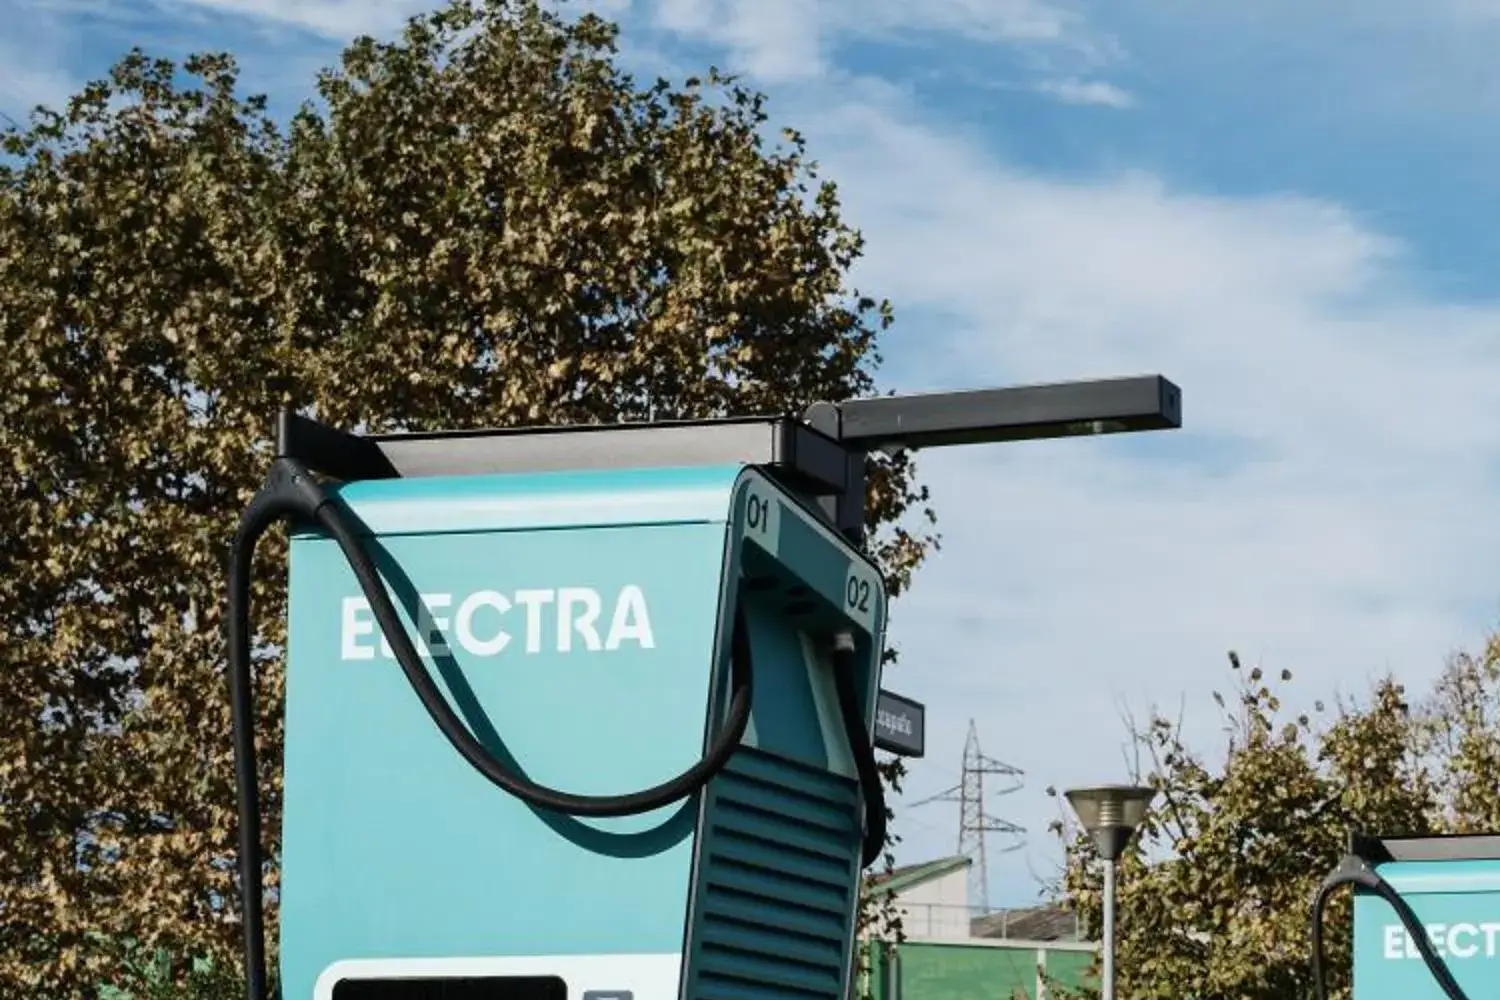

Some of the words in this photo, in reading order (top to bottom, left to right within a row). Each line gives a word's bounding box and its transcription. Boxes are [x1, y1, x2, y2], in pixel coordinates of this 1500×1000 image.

[747, 494, 769, 533] 01
[848, 576, 869, 613] 02
[341, 584, 656, 661] EECTRA
